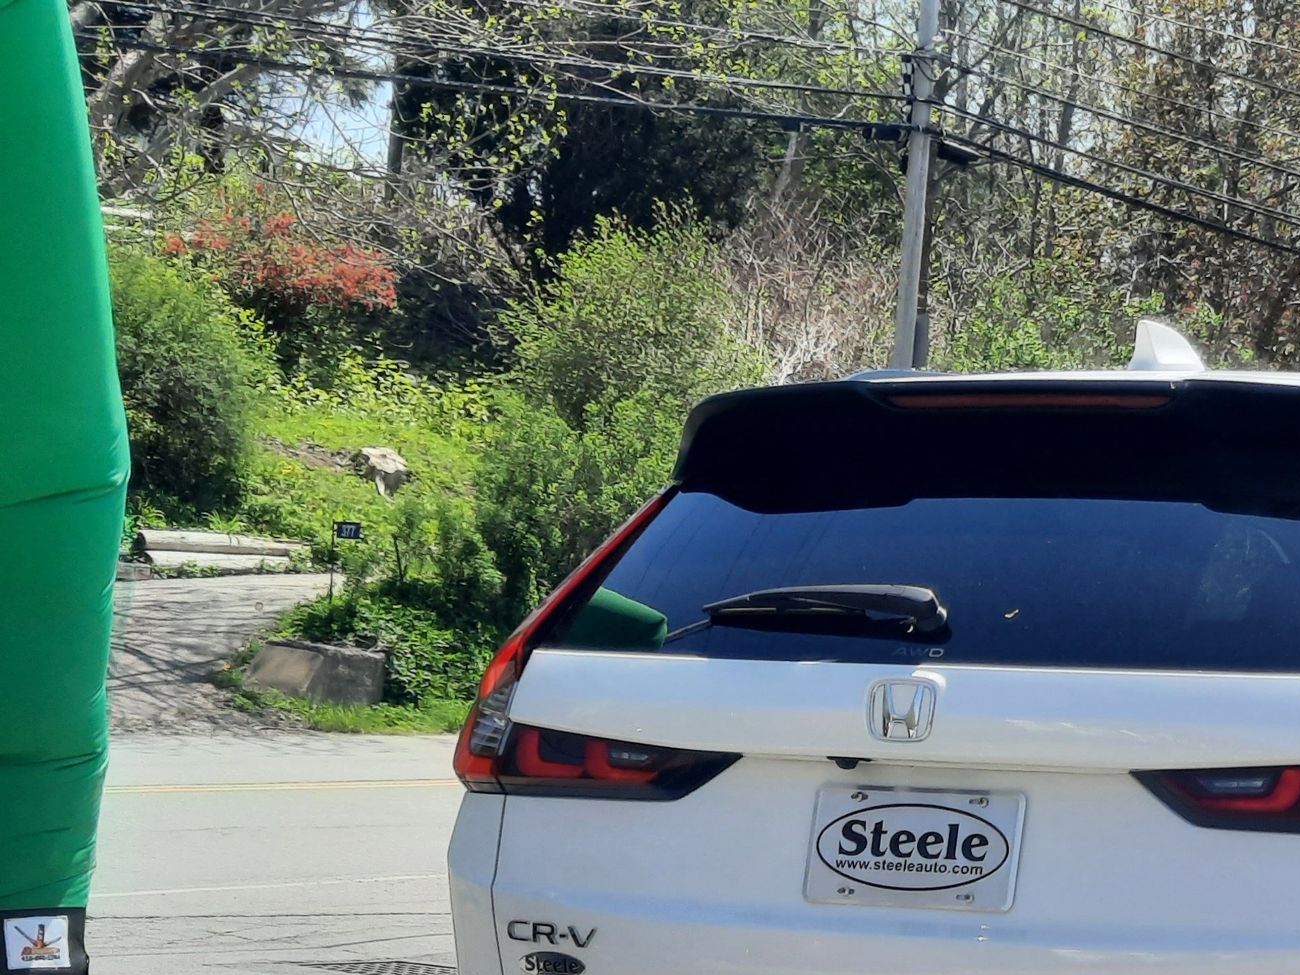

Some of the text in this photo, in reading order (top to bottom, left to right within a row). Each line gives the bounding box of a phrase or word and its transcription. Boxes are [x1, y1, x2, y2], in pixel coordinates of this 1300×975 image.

[891, 647, 945, 658] AWD
[838, 819, 989, 862] Steele
[835, 858, 983, 876] www.steeleauto.com
[507, 920, 598, 948] CR-V
[525, 955, 580, 974] Steele
